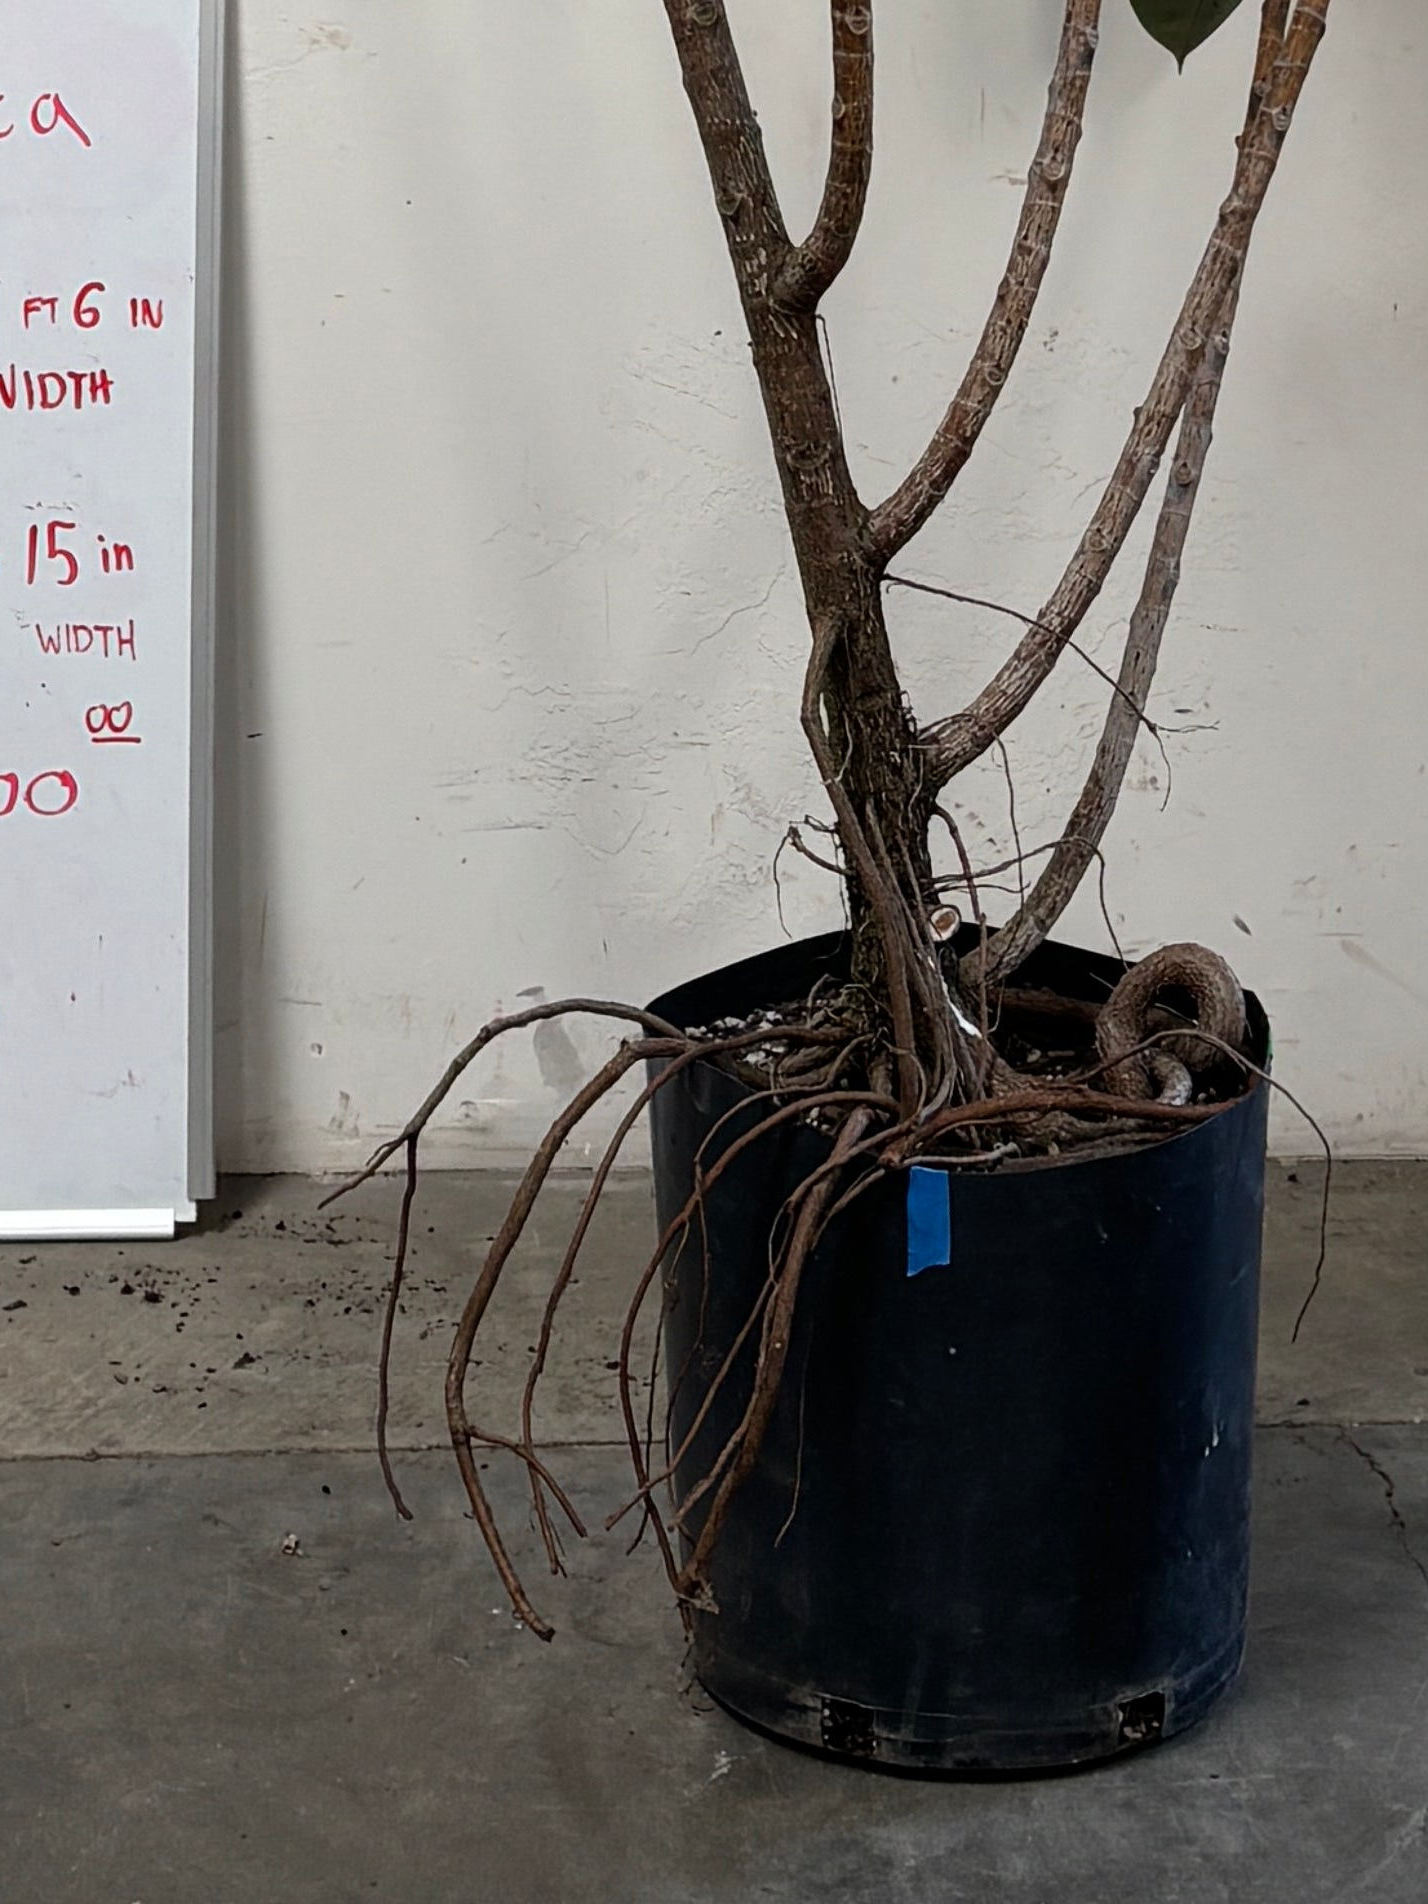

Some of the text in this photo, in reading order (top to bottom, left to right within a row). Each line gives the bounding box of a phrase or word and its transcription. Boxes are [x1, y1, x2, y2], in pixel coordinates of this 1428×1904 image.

[21, 296, 58, 327] FT
[71, 281, 105, 331] 6
[128, 297, 164, 331] IN
[25, 519, 80, 587] 15
[35, 618, 138, 661] WIDTH
